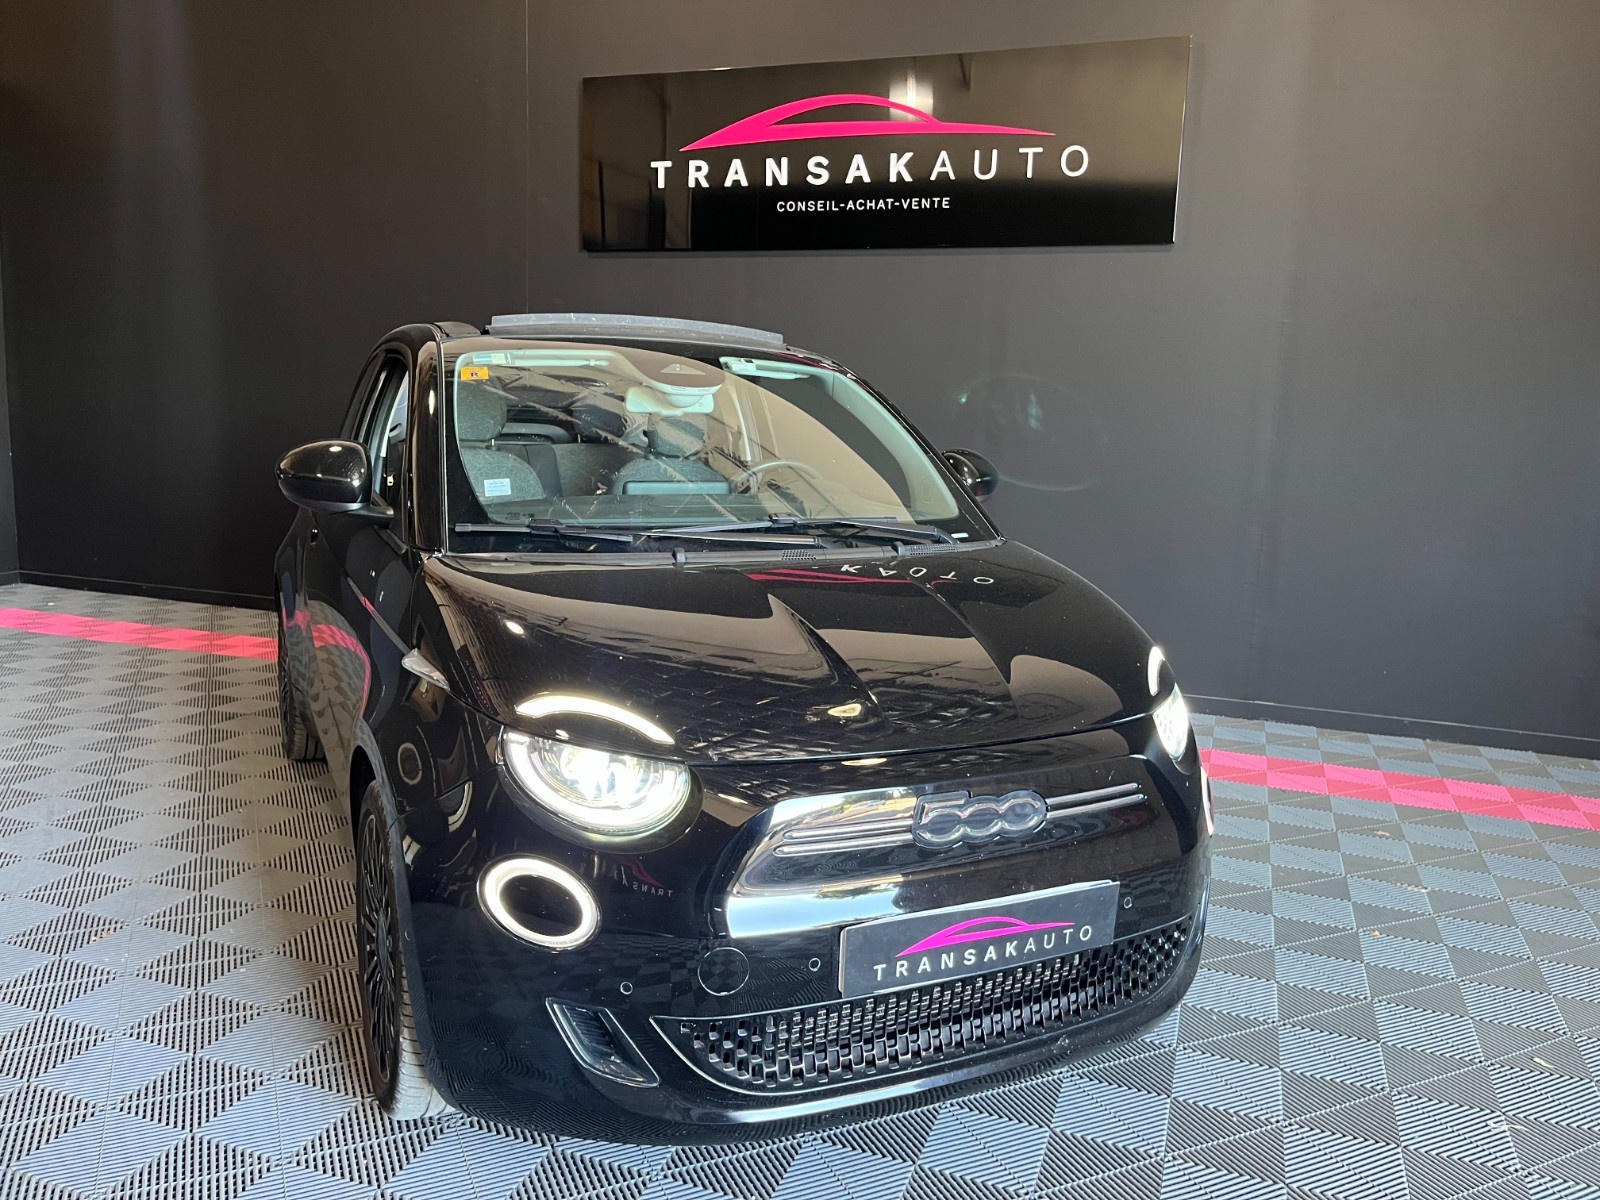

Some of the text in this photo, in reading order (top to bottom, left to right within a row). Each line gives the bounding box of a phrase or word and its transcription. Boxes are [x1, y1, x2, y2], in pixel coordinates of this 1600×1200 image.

[651, 145, 1090, 189] TRANSAKAUTO
[776, 196, 951, 213] CONSEIL-ACHAT-VENTE
[913, 793, 1045, 845] 500
[873, 925, 1093, 981] TRANSAKAUTO
